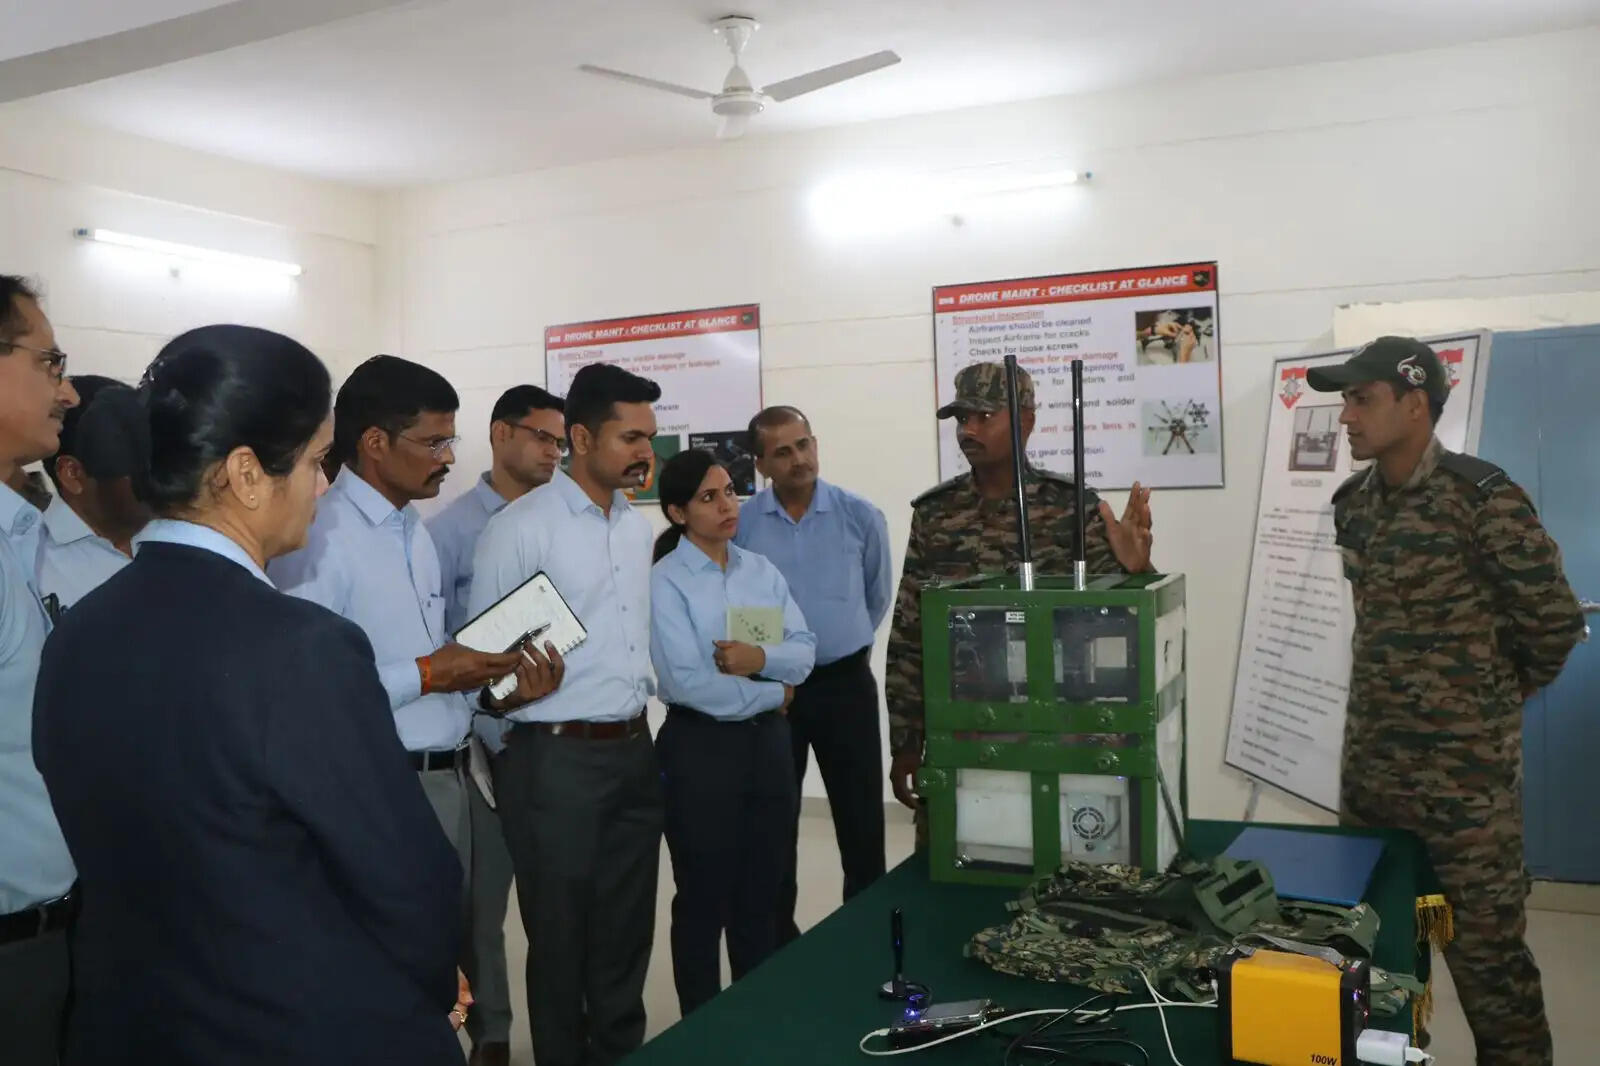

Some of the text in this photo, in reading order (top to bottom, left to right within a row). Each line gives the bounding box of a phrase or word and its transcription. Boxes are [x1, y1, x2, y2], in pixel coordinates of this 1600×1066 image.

[959, 291, 998, 304] DRONE
[1001, 288, 1039, 301] MAINT
[1049, 280, 1115, 296] CHECKLIST
[1119, 279, 1134, 290] AT
[1138, 274, 1189, 289] GLANCE
[564, 331, 594, 341] DRONE
[596, 328, 625, 340] MAINT
[631, 321, 682, 335] CHECKLIST
[684, 319, 697, 329] AT
[698, 315, 737, 328] GLANCE
[969, 317, 1091, 333] Airframe should be cleaned
[969, 342, 1078, 356] Checks for loose screws
[1048, 354, 1061, 362] for
[1082, 351, 1118, 361] damage
[1082, 375, 1106, 384] ebris
[1311, 1053, 1337, 1066] 100W
